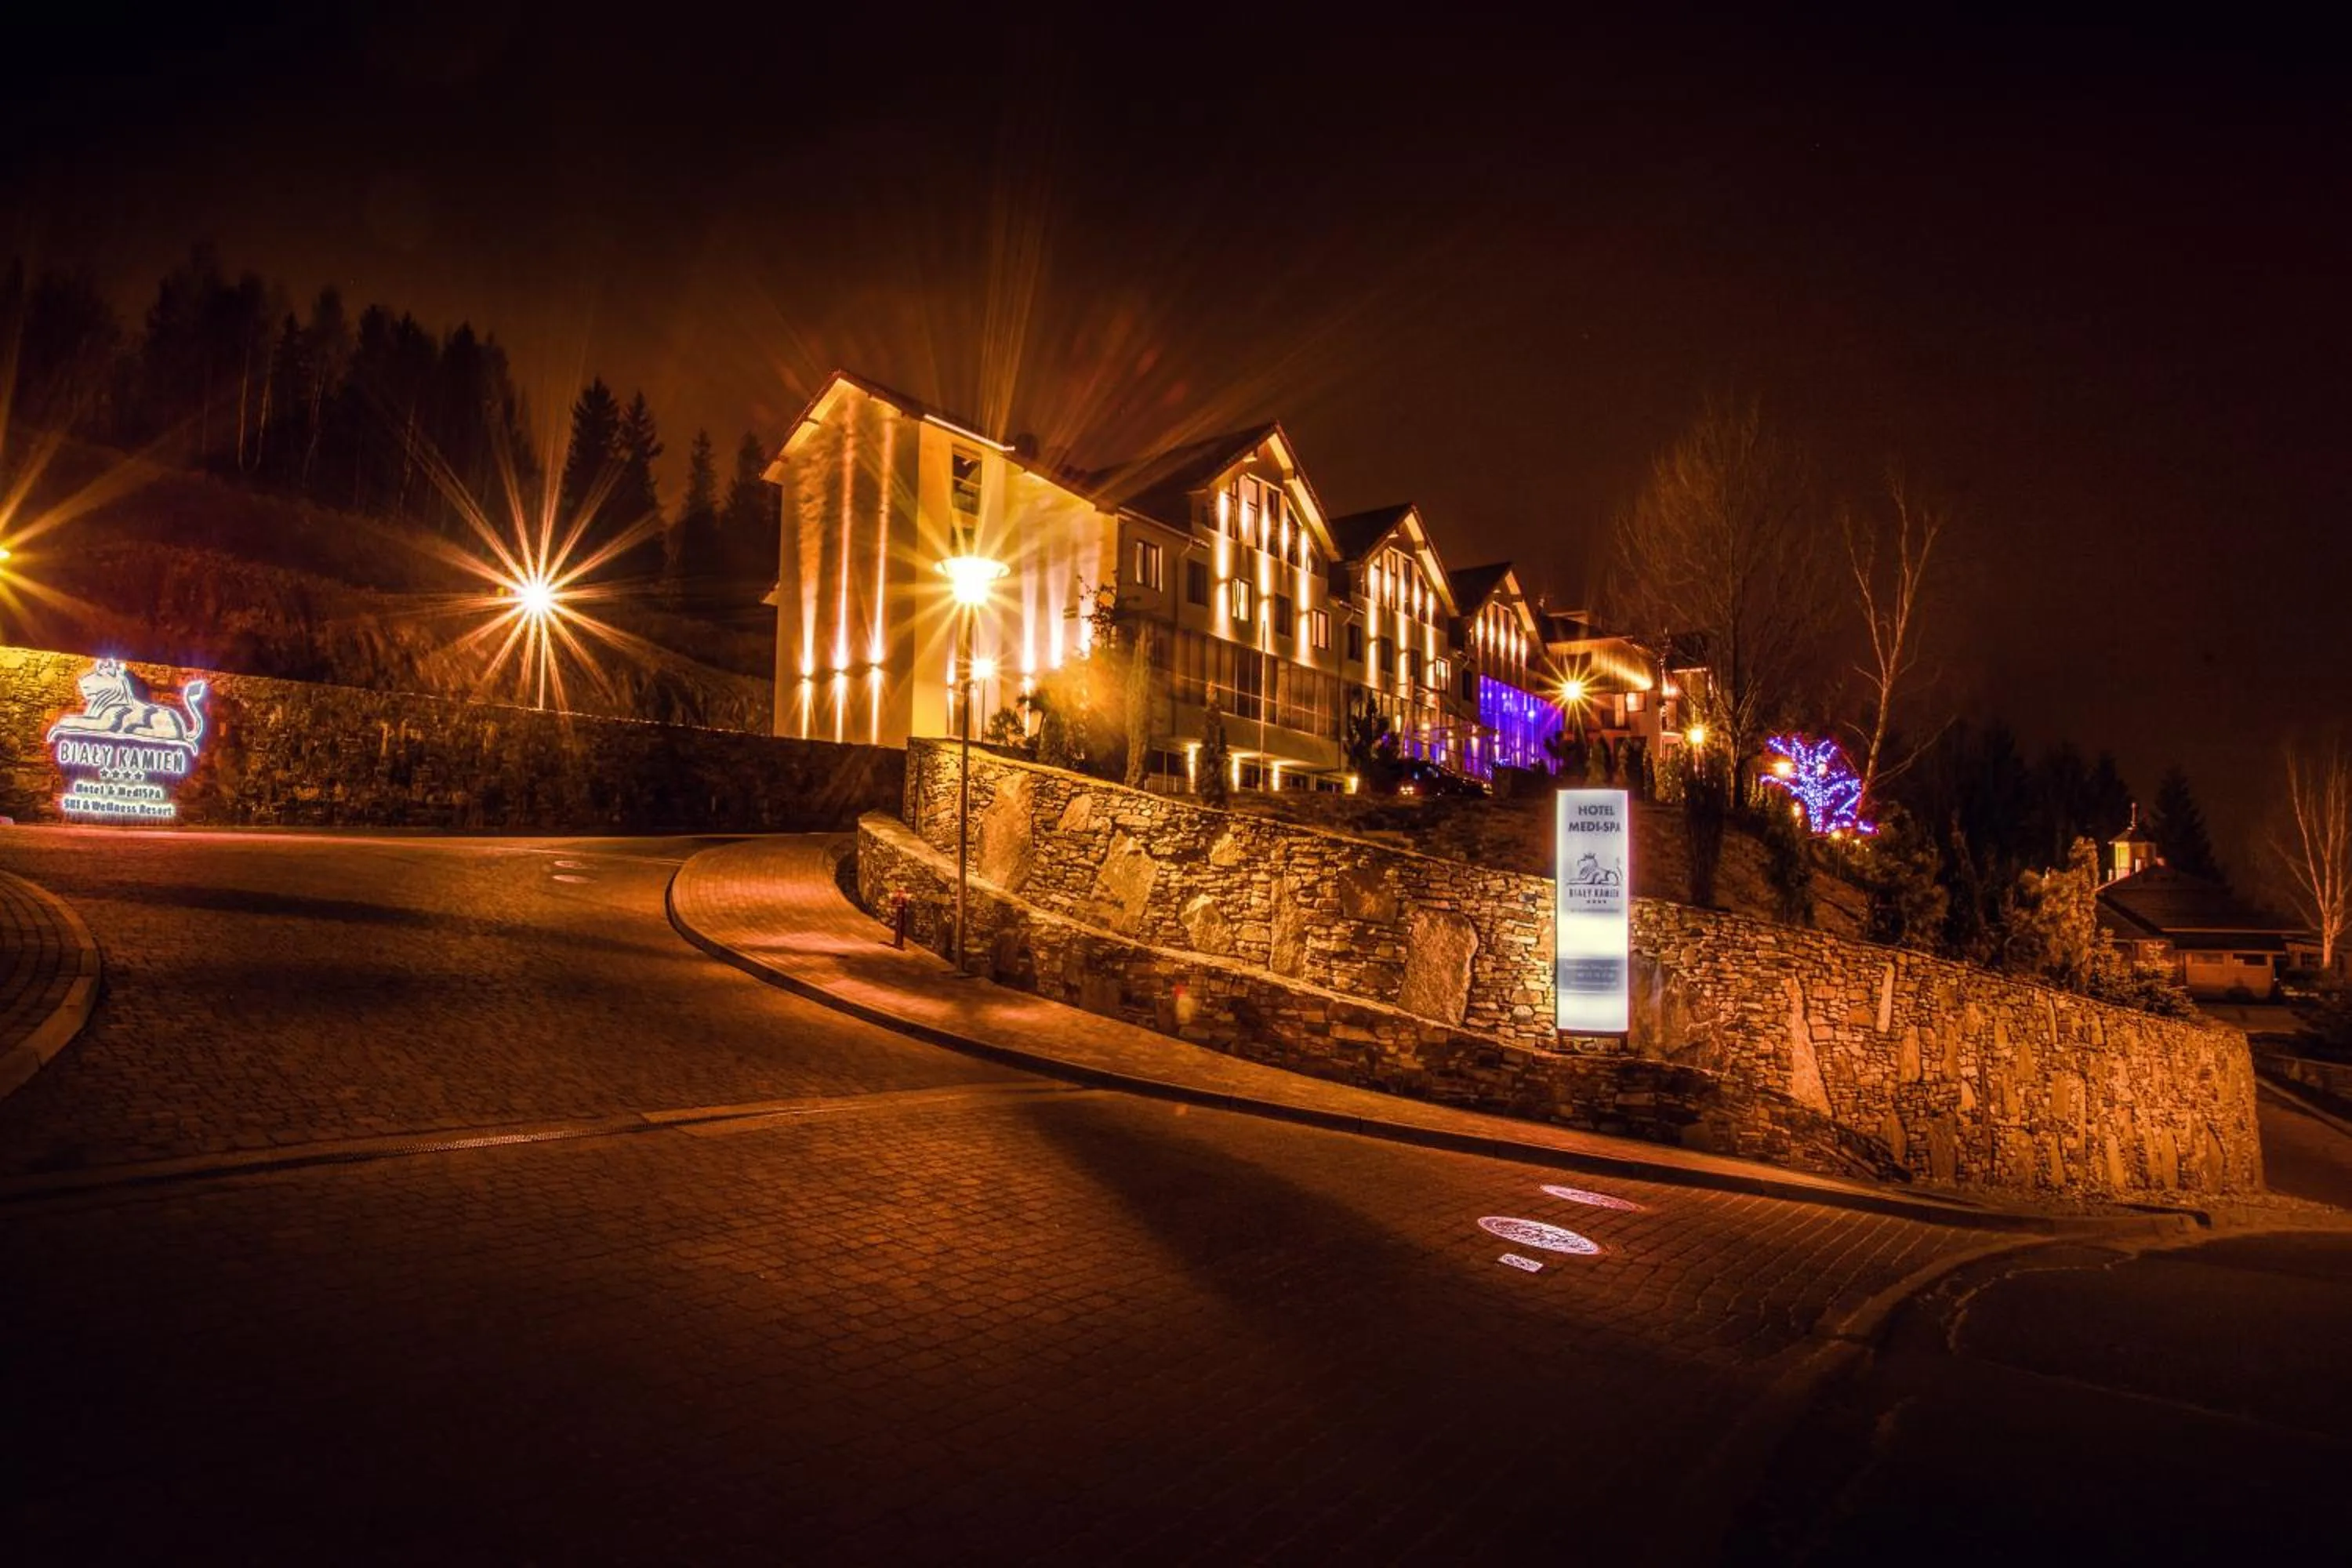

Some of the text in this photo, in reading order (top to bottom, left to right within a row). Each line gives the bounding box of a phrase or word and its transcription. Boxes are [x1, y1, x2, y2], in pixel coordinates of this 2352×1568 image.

[60, 742, 111, 766] BIAŁY
[75, 783, 104, 795] Hotel
[92, 800, 136, 813] Wellness
[140, 804, 172, 815] Resort
[1577, 804, 1615, 816] HOTEL
[1568, 821, 1621, 833] MEDI-SPA
